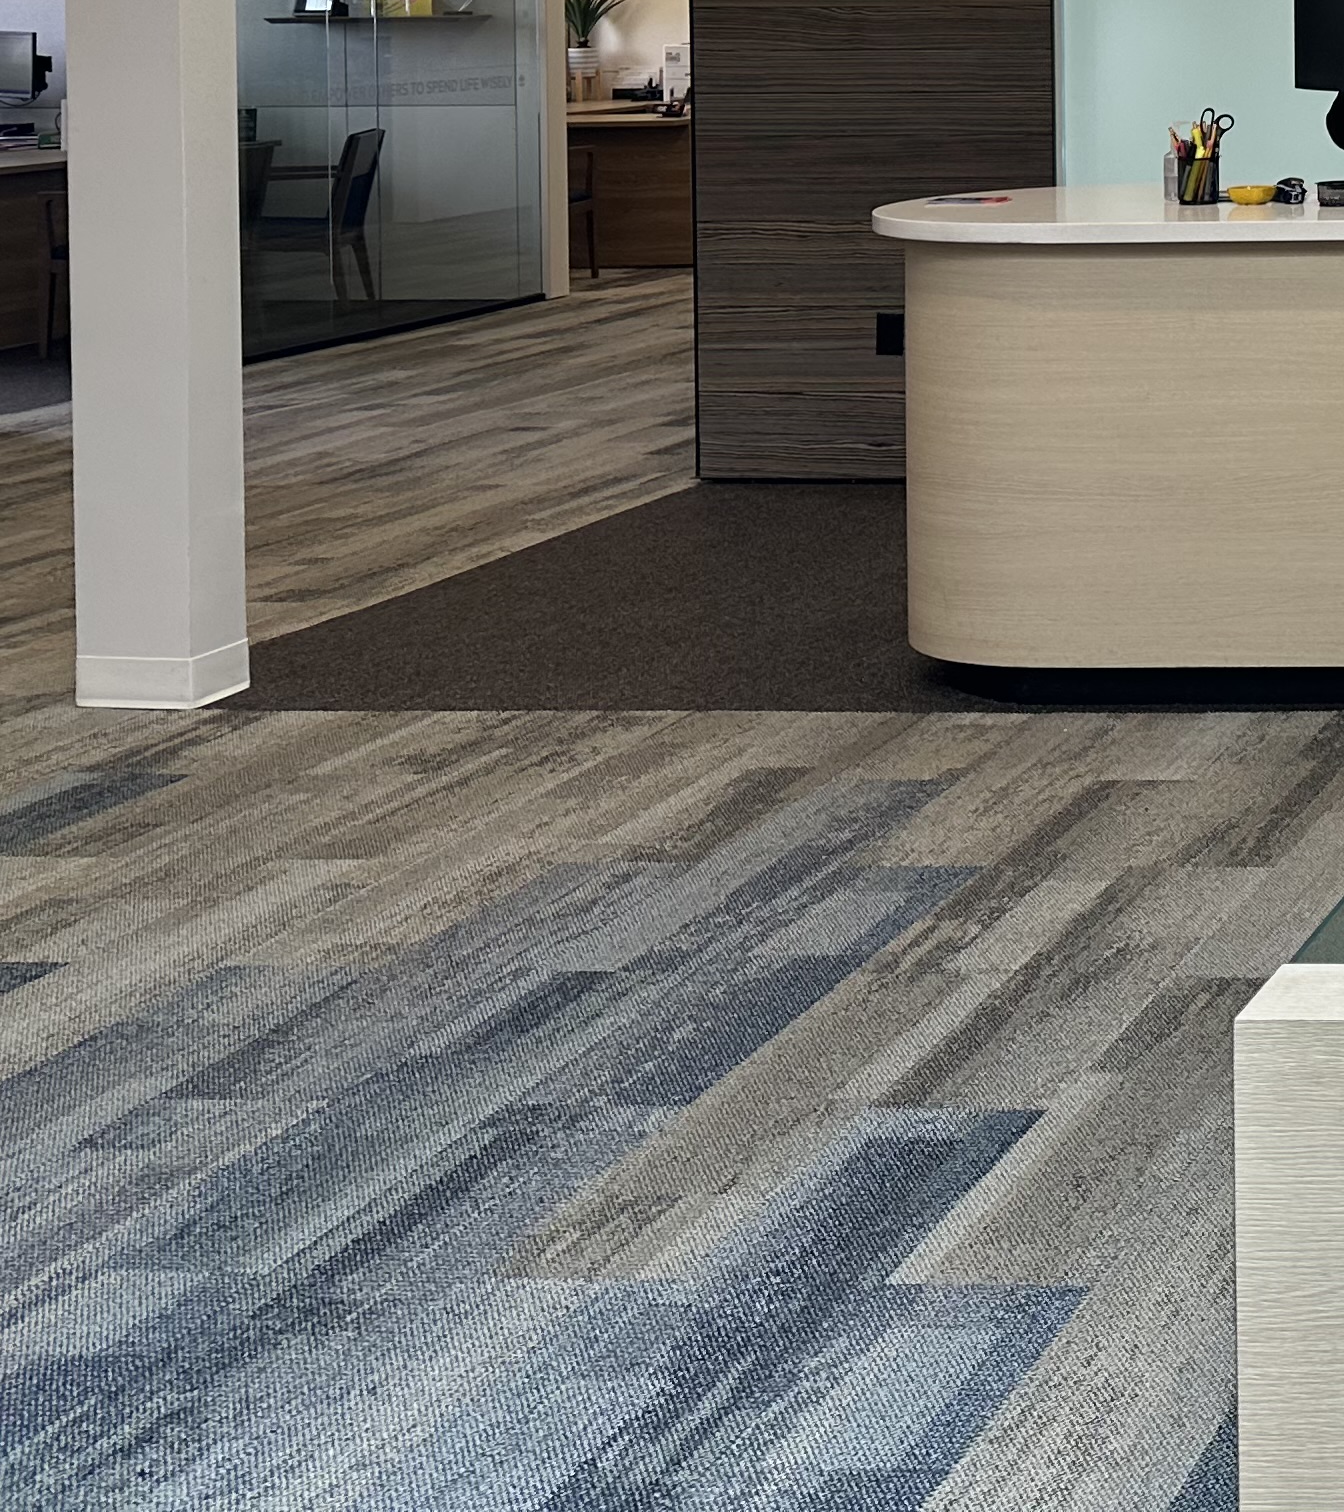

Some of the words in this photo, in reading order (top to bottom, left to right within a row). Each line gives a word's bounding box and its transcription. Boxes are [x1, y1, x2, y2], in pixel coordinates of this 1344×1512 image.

[409, 82, 423, 95] TO
[425, 79, 456, 94] SPEND
[459, 77, 479, 92] LIFE
[479, 75, 513, 89] WISELY
